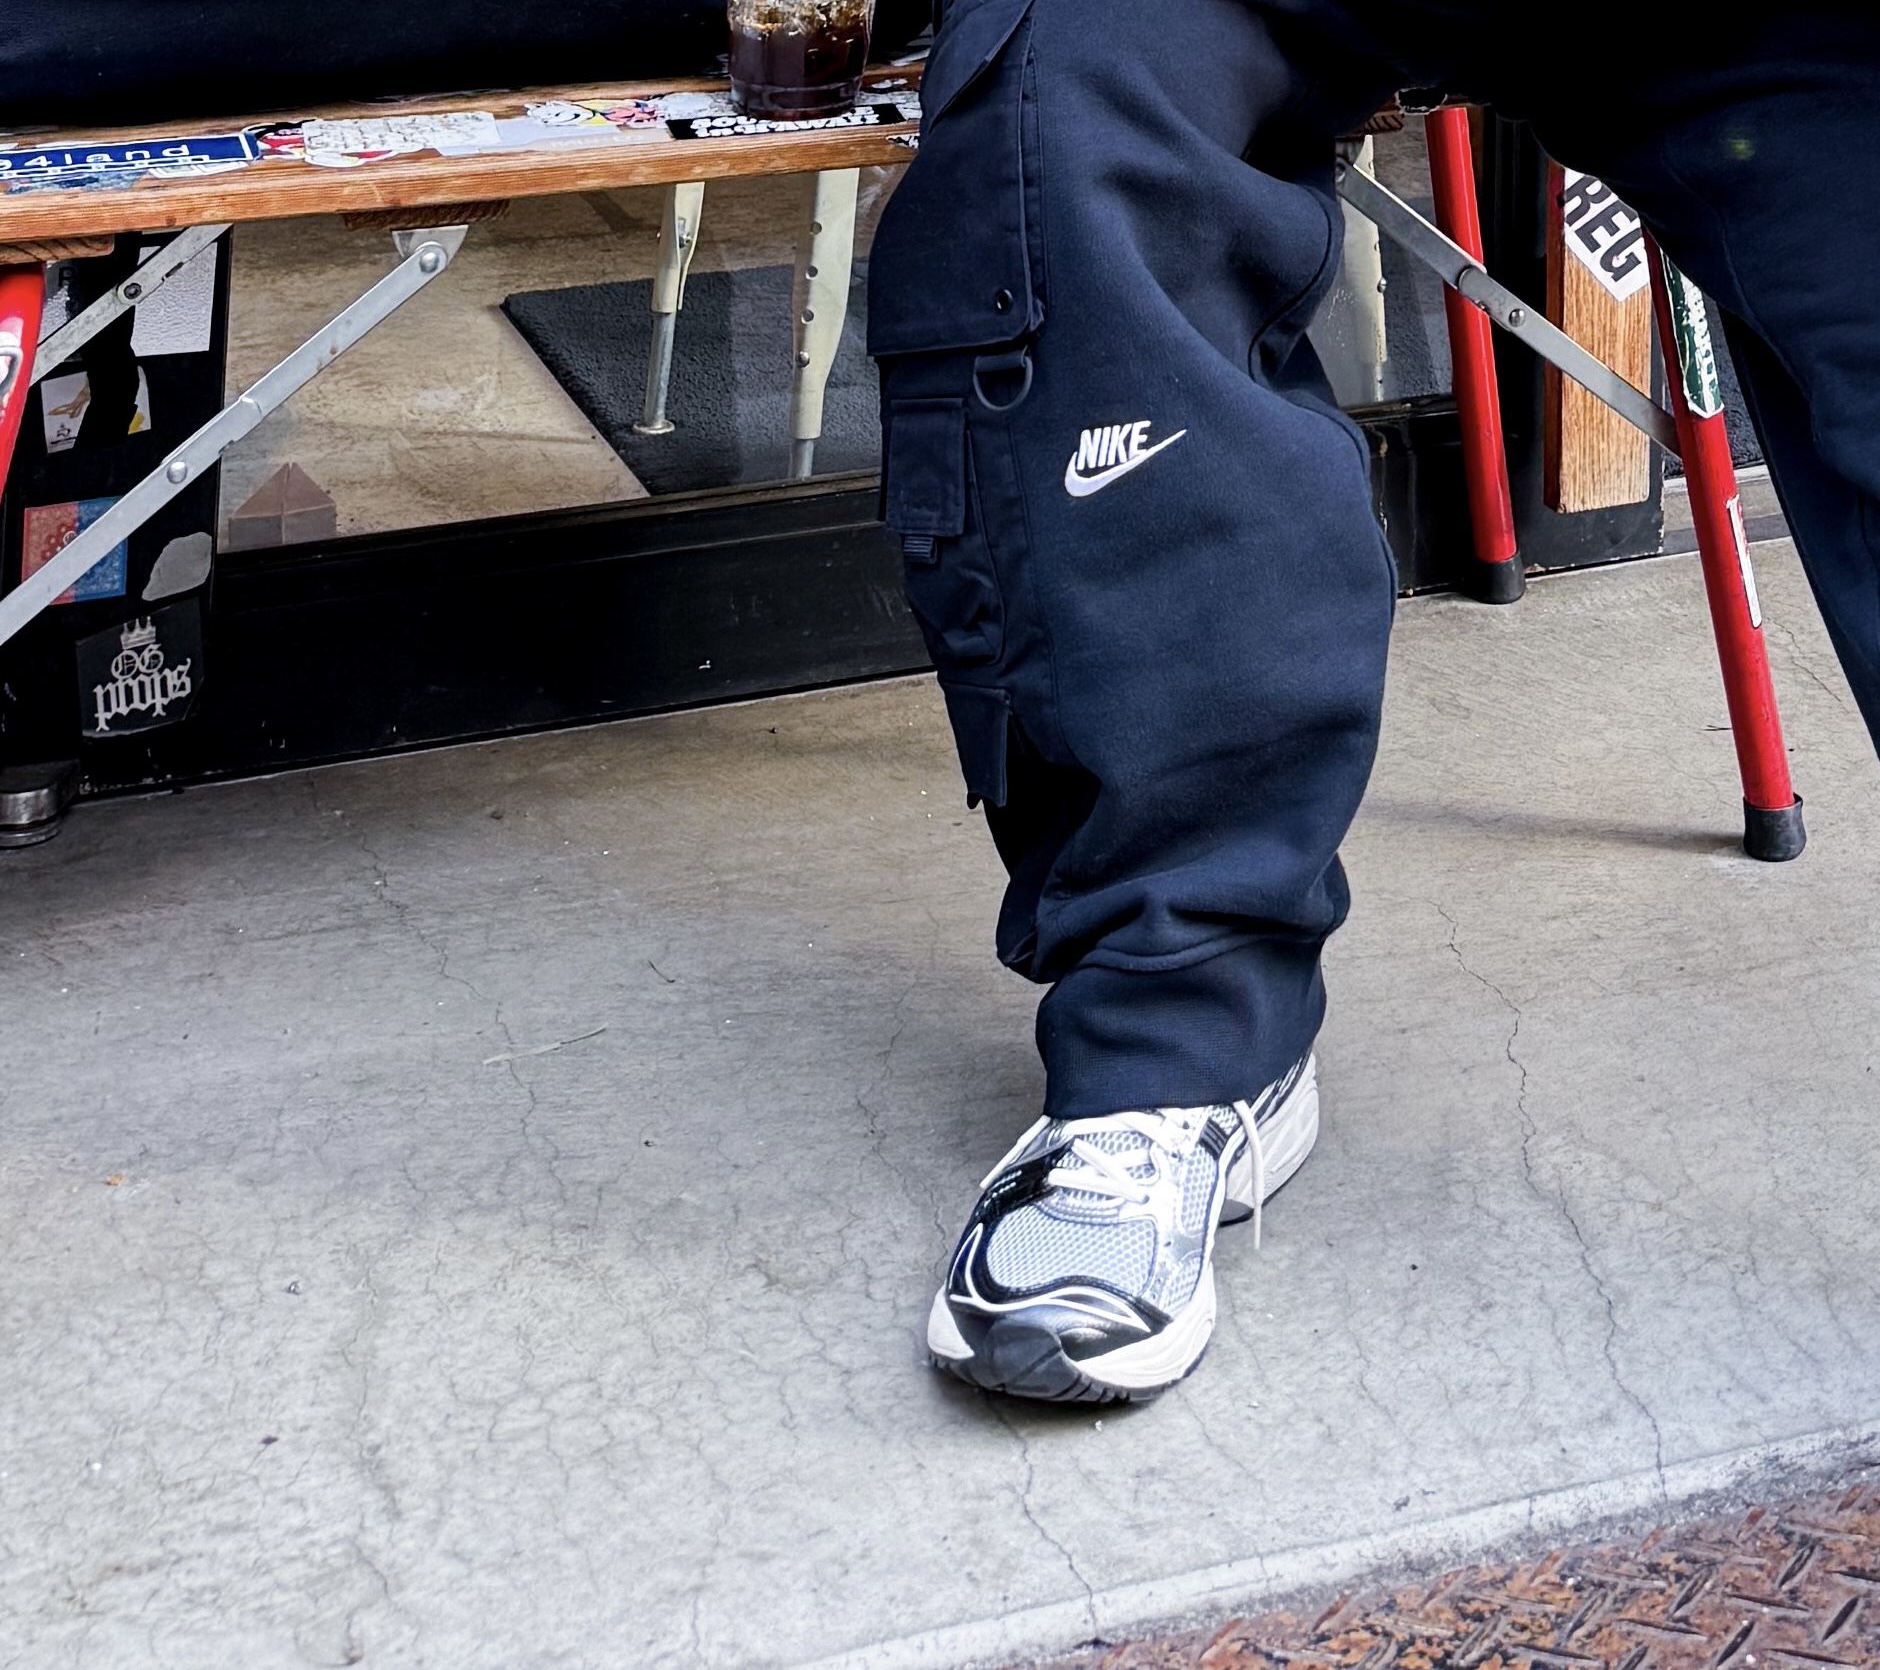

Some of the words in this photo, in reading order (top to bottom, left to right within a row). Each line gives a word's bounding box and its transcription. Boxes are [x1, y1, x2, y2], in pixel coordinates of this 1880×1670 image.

[1076, 420, 1152, 472] NIKE
[110, 643, 165, 681] OG
[93, 658, 192, 733] props
